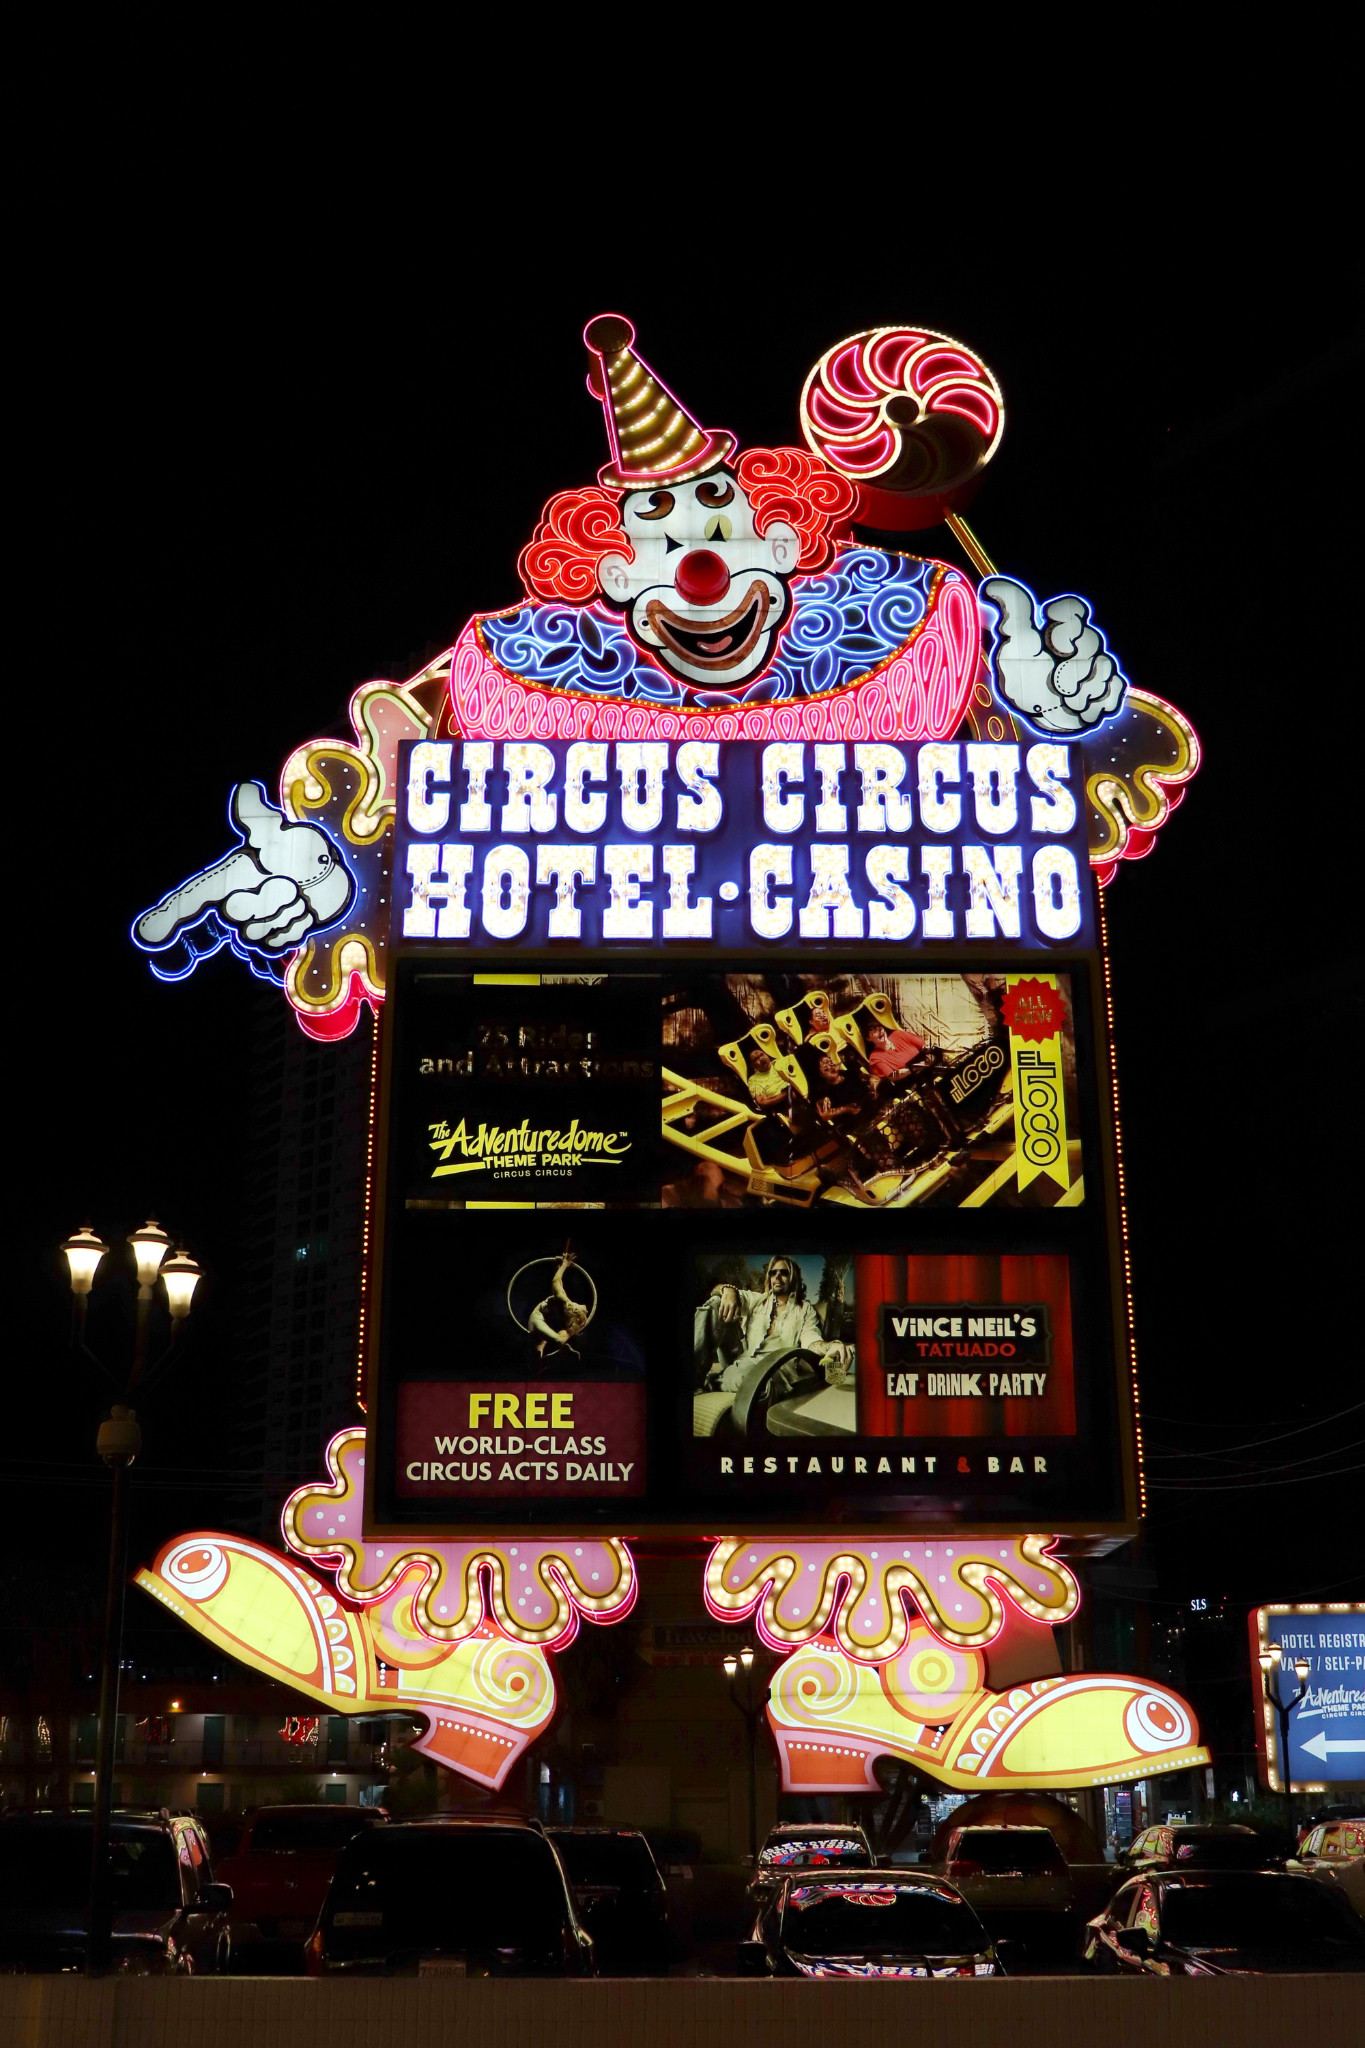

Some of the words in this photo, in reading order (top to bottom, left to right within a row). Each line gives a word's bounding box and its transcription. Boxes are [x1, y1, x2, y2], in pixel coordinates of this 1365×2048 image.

[406, 741, 723, 833] CIRCUS
[762, 741, 1075, 833] CIRCUS
[403, 843, 713, 939] HOTEL
[749, 844, 1082, 940] CASINO
[1018, 995, 1047, 1008] ALL
[1015, 1009, 1052, 1024] NEW
[419, 1051, 474, 1075] and
[1017, 1051, 1056, 1066] EL
[428, 1120, 451, 1140] The
[429, 1117, 632, 1160] Adventuredome
[483, 1153, 537, 1169] THEME
[542, 1153, 582, 1167] PARK
[493, 1170, 531, 1179] CIRCUS
[535, 1169, 573, 1178] CIRCUS
[916, 1342, 1016, 1357] TATUADO
[887, 1373, 919, 1396] EAT
[928, 1373, 983, 1396] DRINK
[989, 1373, 1047, 1396] PARTY
[469, 1393, 575, 1429] FREE
[434, 1436, 607, 1455] WORLD-CLASS
[406, 1462, 492, 1481] CIRCUS
[498, 1462, 559, 1481] ACTS
[565, 1463, 635, 1481] DAILY
[720, 1456, 936, 1474] RESTAURANT
[957, 1456, 971, 1473] &
[987, 1456, 1048, 1473] BAR
[1190, 1598, 1207, 1611] SLS
[1281, 1634, 1315, 1649] HOTEL
[1280, 1656, 1313, 1672] VAT
[1321, 1704, 1350, 1714] THEME
[1321, 1711, 1348, 1719] CIRCUS
